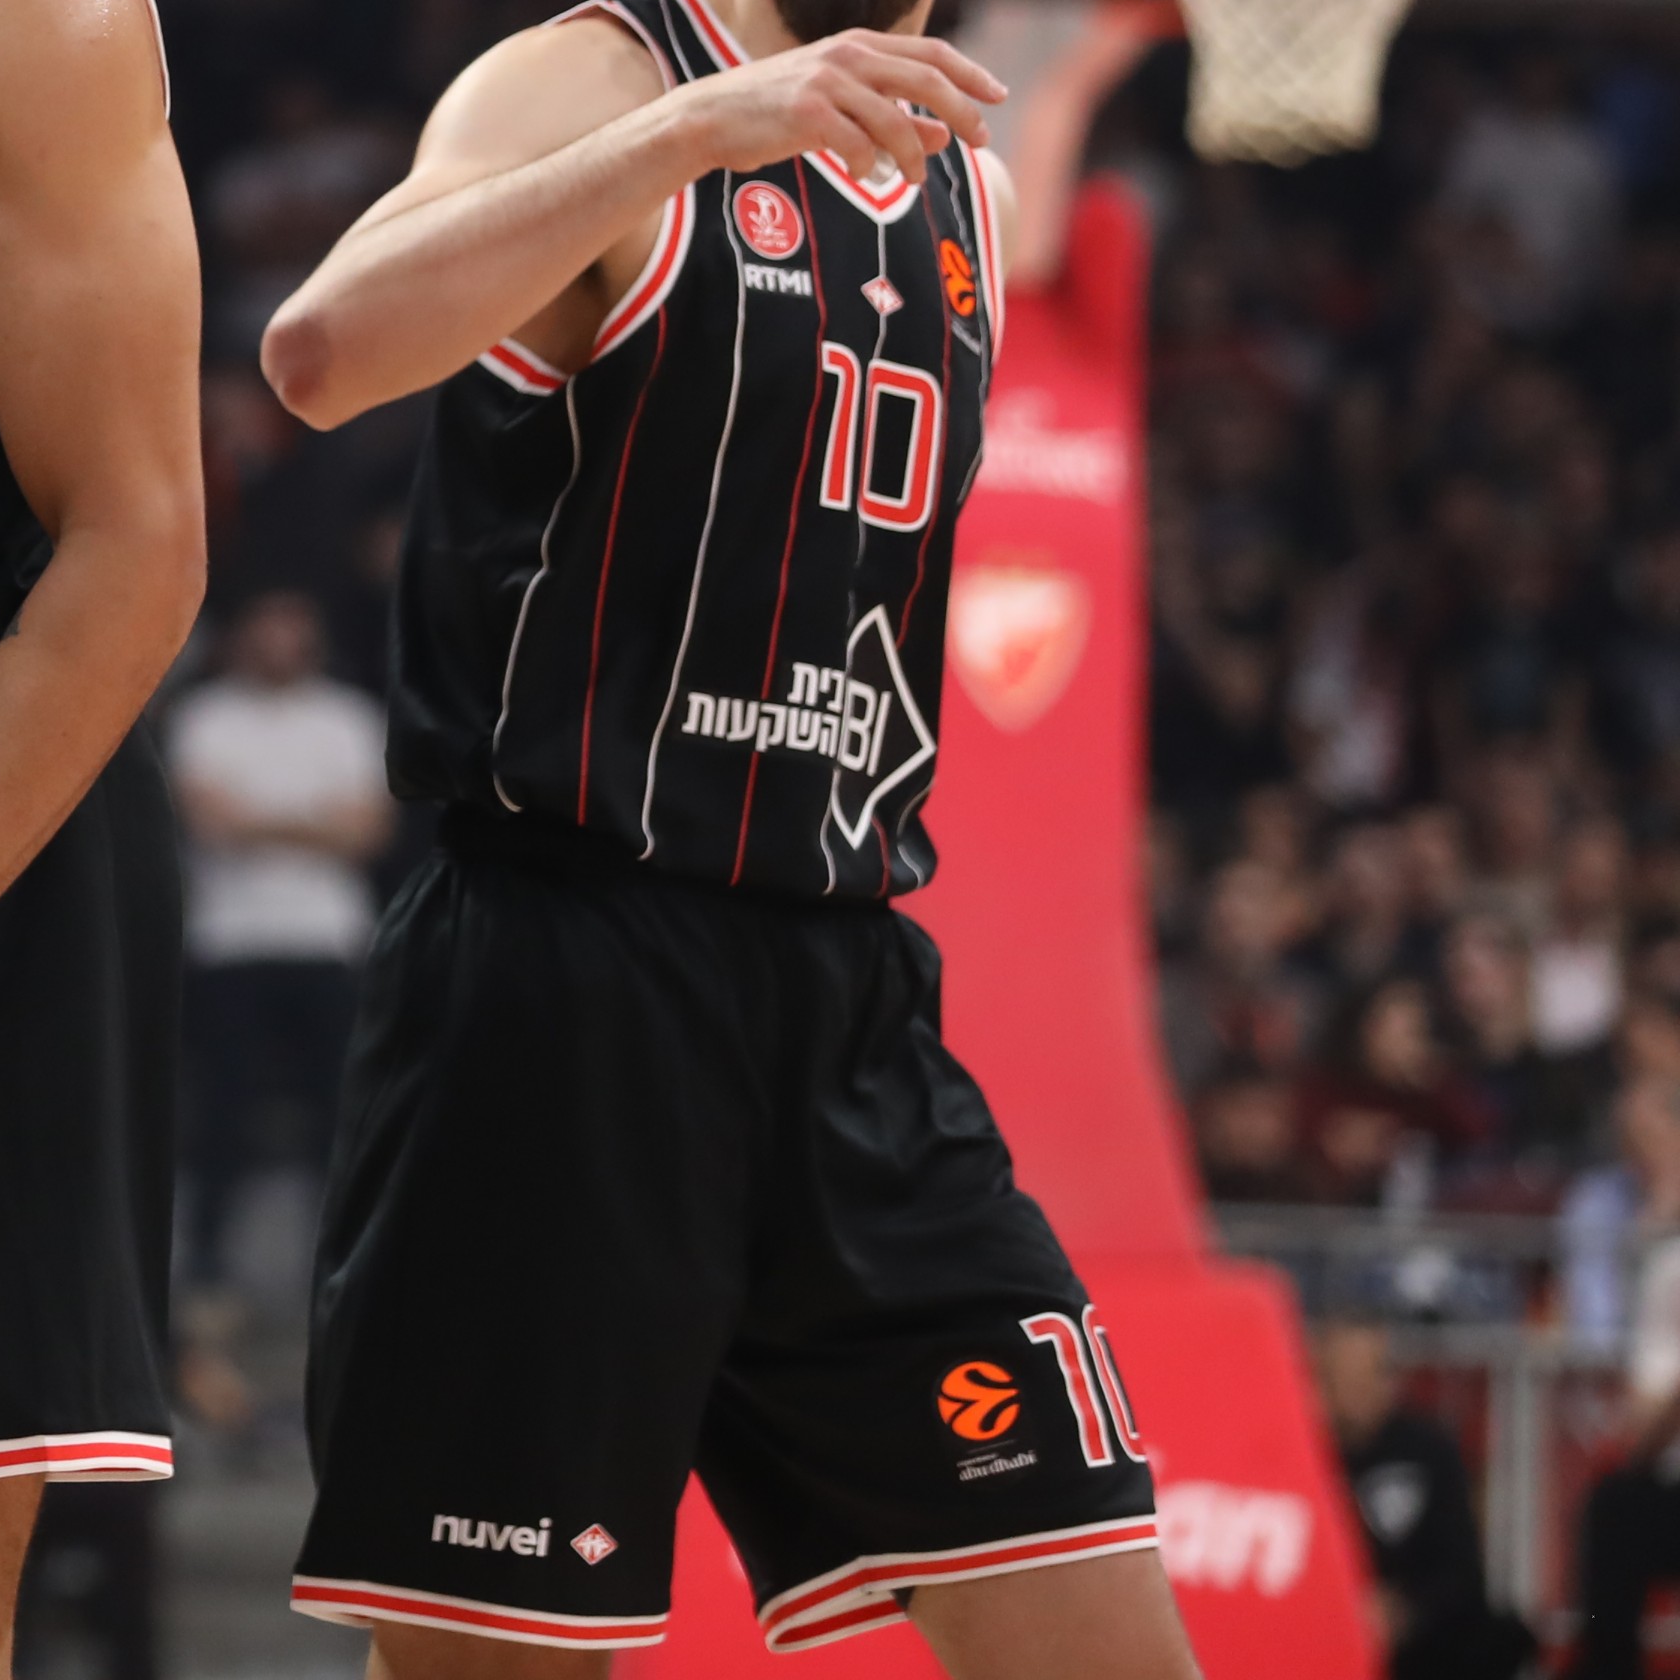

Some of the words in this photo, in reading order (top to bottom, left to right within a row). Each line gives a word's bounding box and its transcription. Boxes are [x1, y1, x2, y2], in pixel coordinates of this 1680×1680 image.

[743, 263, 814, 298] RTMI
[819, 339, 944, 533] 10
[787, 661, 846, 714] בית
[681, 691, 841, 754] השקעות
[431, 1513, 553, 1558] nuvei
